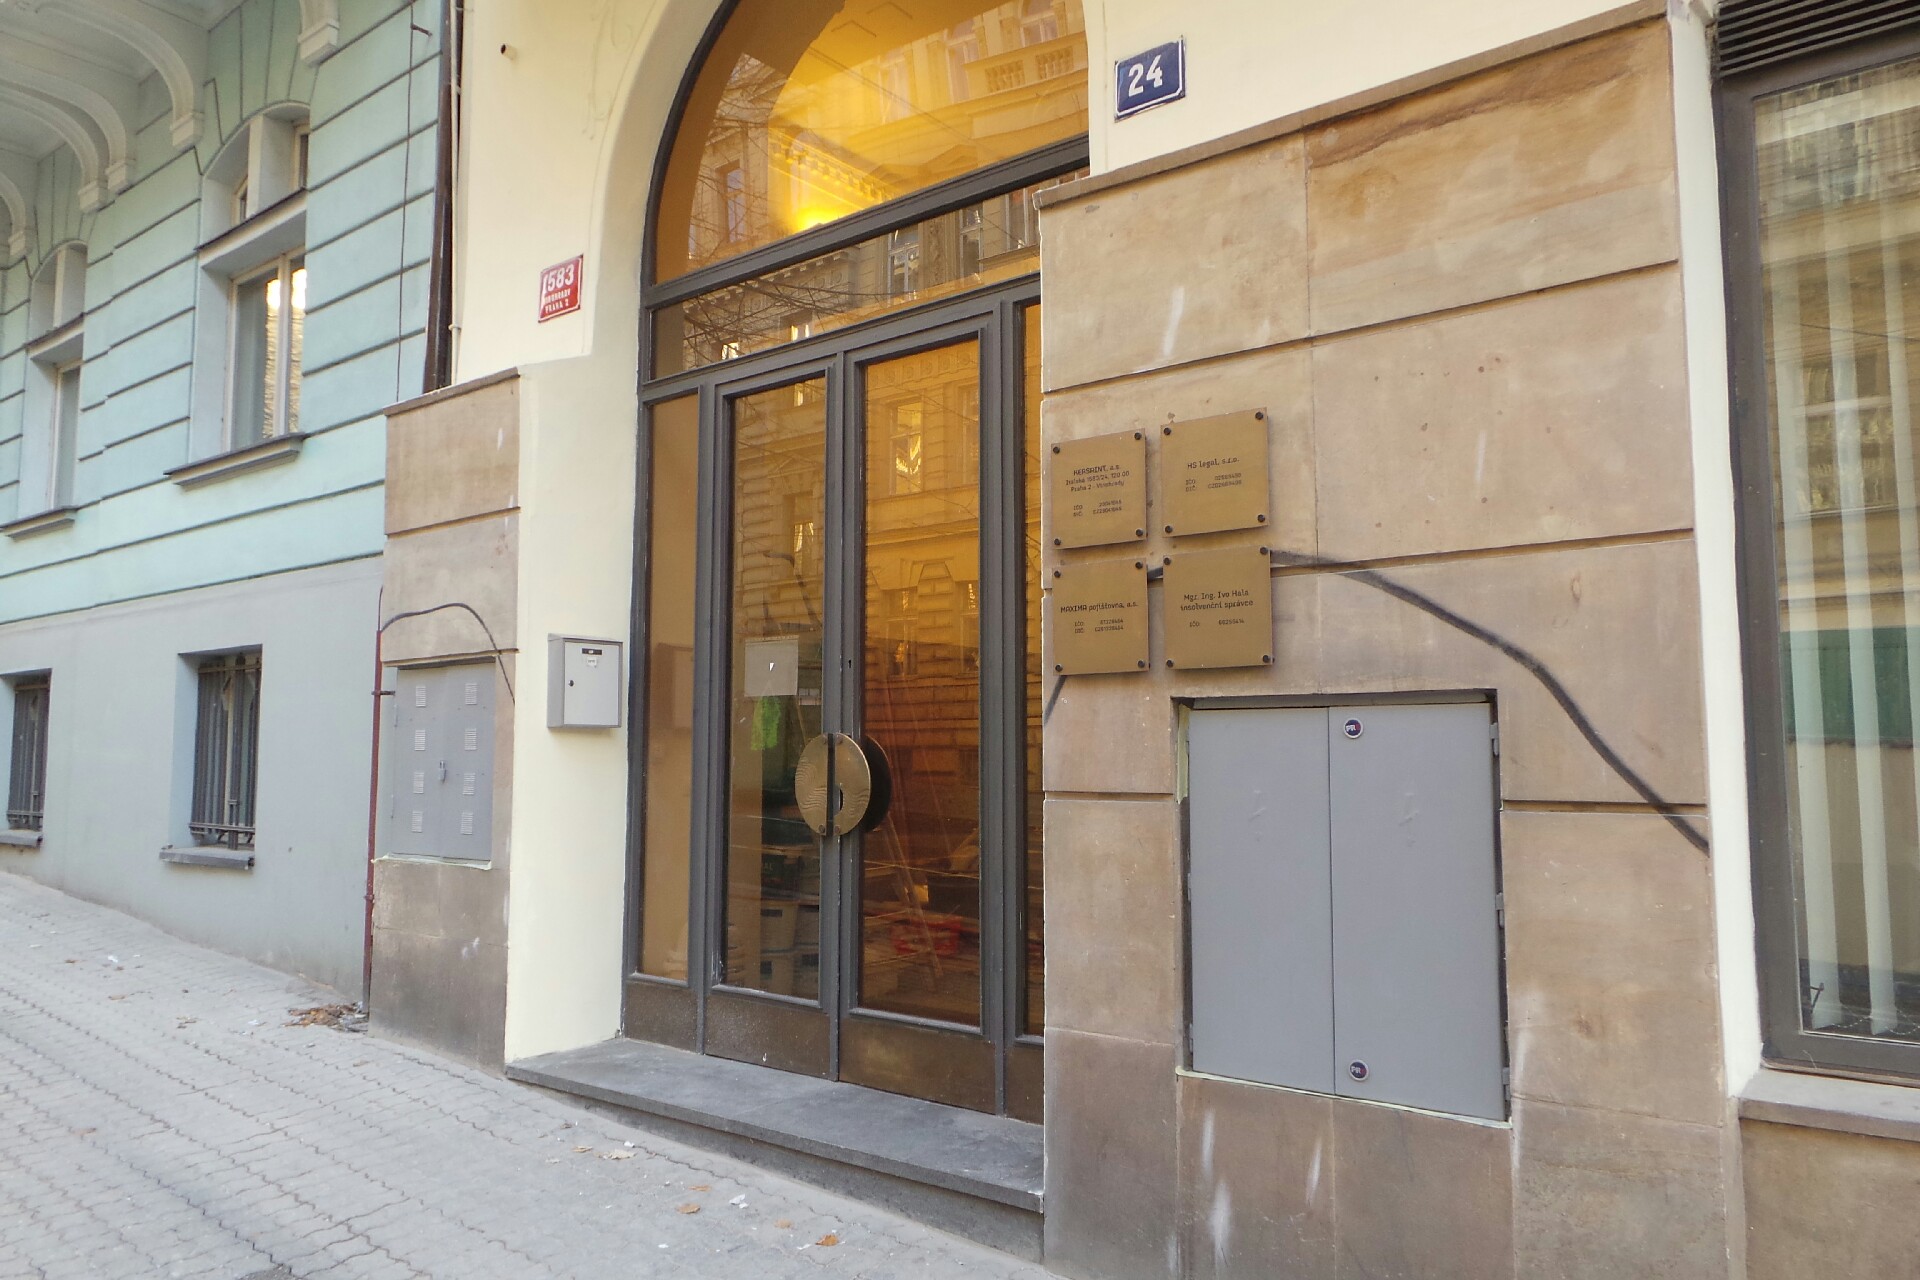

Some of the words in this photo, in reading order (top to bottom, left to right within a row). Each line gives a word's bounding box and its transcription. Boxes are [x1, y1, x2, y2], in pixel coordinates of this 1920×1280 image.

[1128, 54, 1163, 97] 24
[1187, 461, 1198, 469] HS
[1183, 594, 1199, 603] Mgr.
[1201, 592, 1216, 601] Ing.
[1217, 591, 1230, 599] Ivo
[1060, 604, 1088, 613] MAXIMA
[1180, 601, 1223, 611] insolvenční
[1224, 600, 1254, 609] správce
